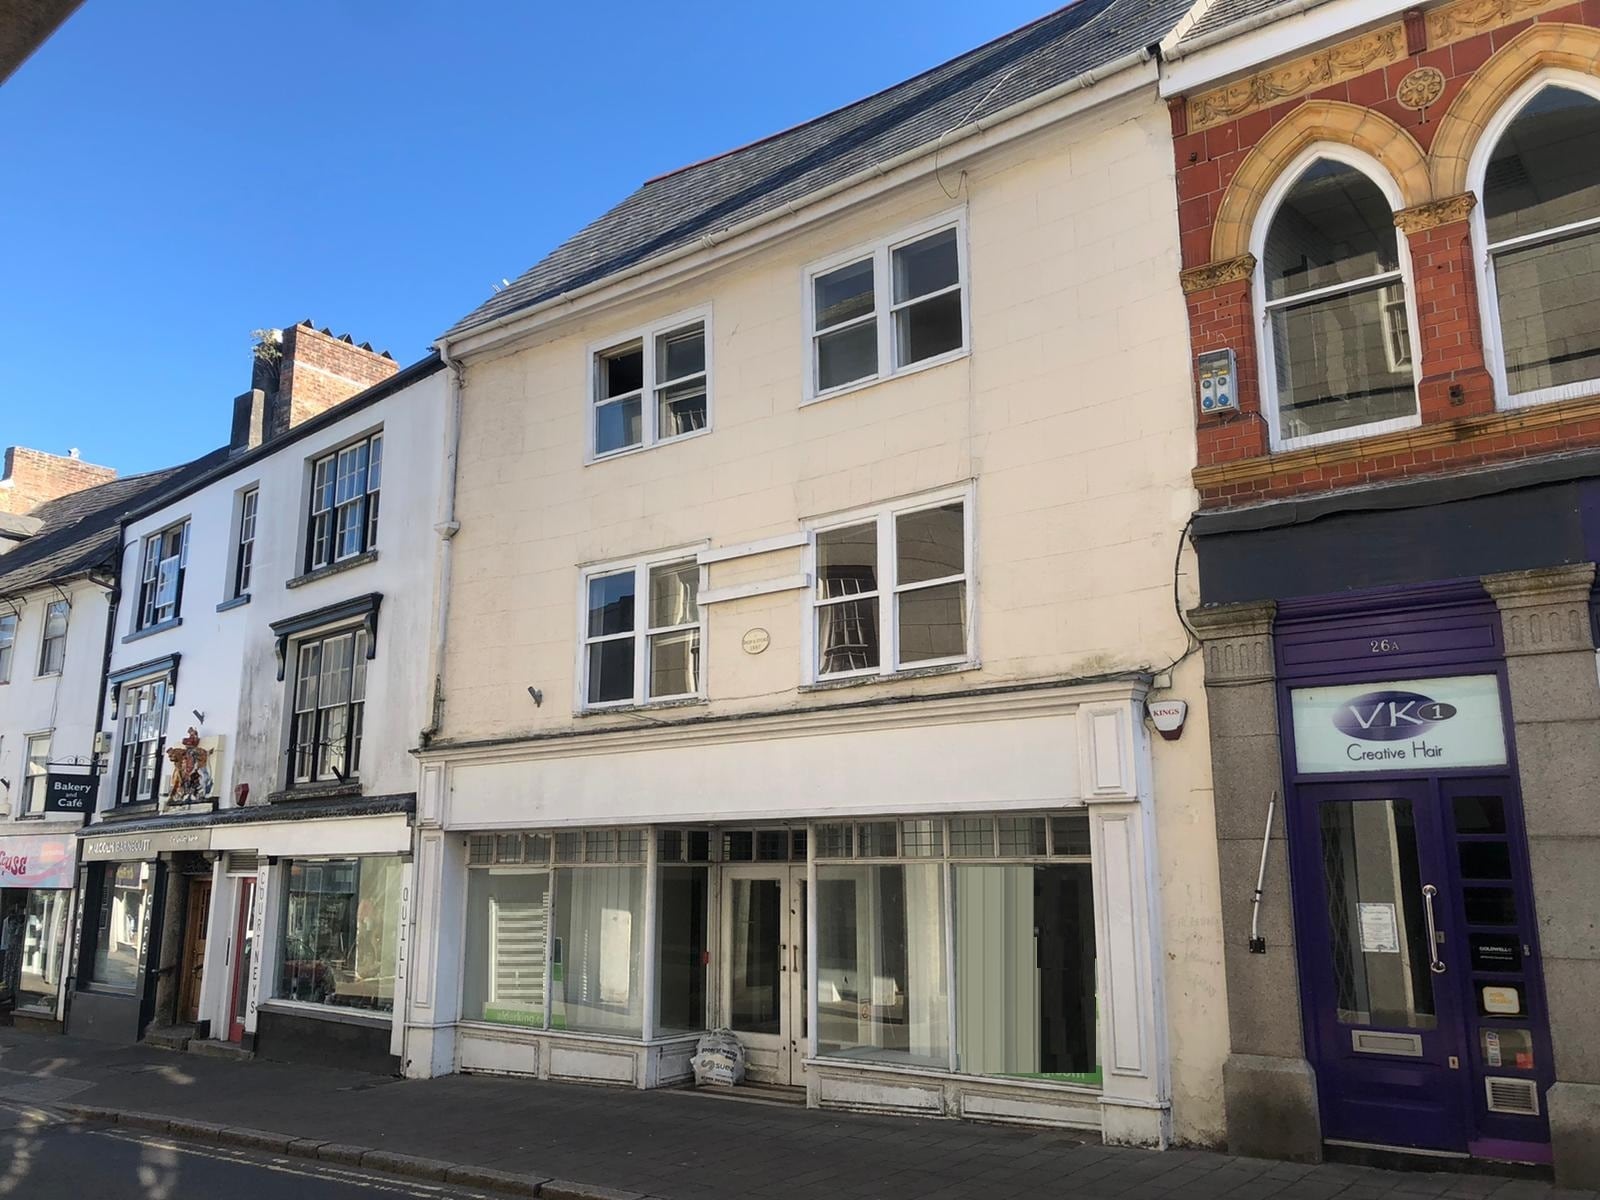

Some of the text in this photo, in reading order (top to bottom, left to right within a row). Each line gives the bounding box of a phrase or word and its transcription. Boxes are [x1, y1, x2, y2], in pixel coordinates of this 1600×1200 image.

[1370, 638, 1400, 653] 26A
[1153, 709, 1180, 717] KINGS
[1346, 740, 1443, 761] Creative Hair
[54, 781, 92, 794] Bakery
[57, 798, 83, 808] Café
